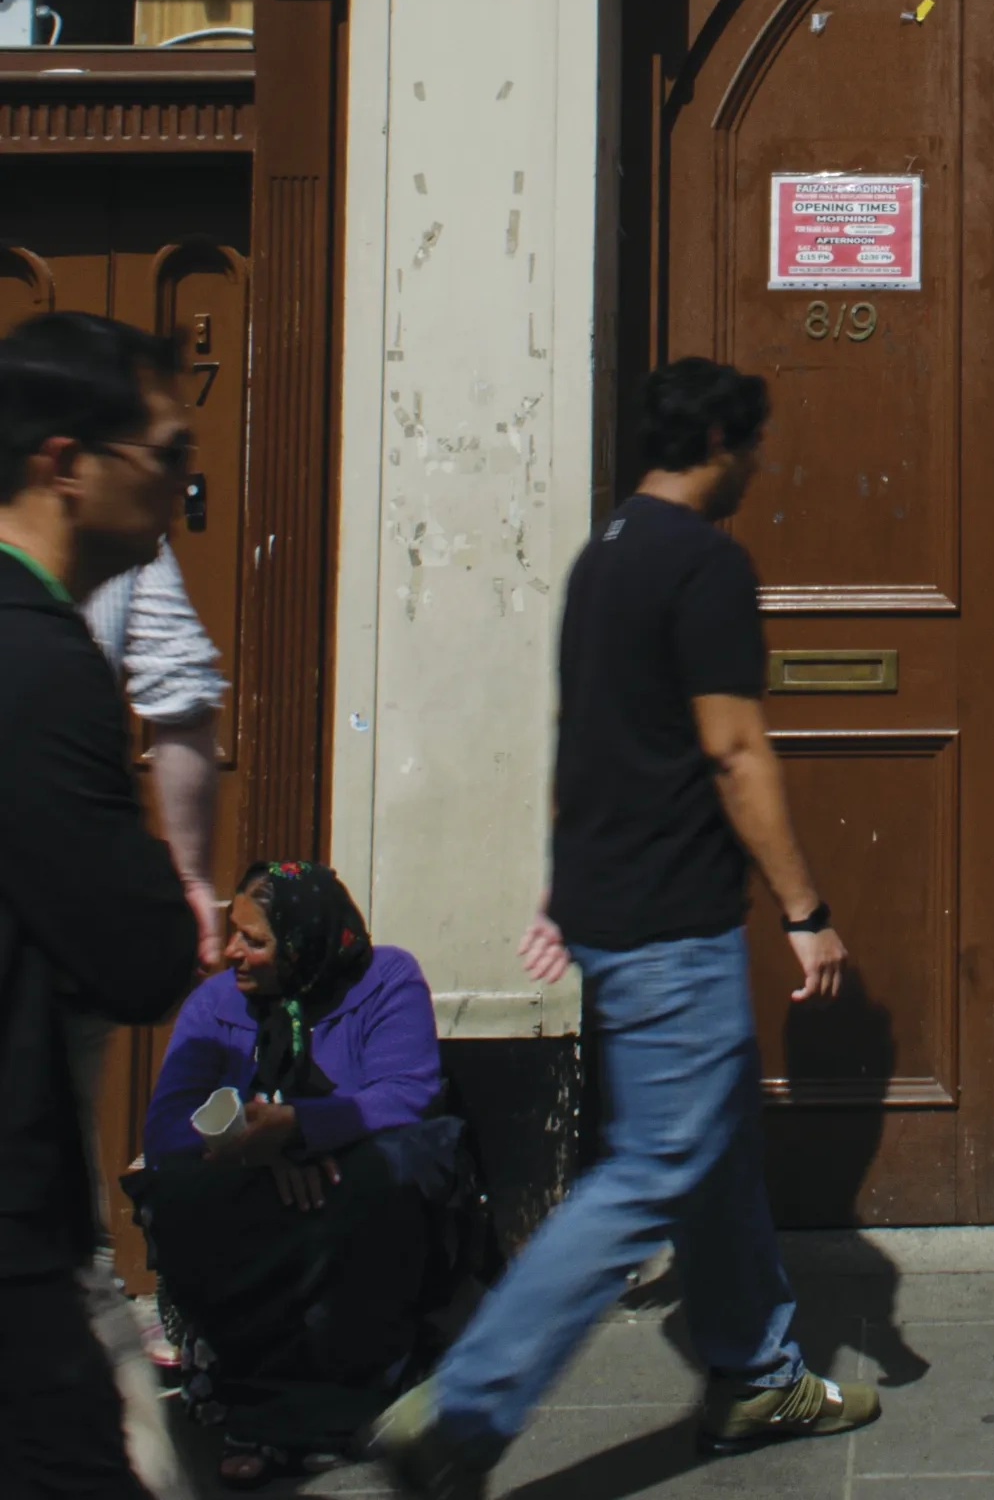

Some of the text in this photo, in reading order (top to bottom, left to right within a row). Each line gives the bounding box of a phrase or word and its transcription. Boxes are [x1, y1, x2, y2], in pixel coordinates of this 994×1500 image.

[796, 184, 897, 194] FAIZAN-EADINAH
[794, 203, 897, 212] OPENING TIMES
[816, 215, 876, 223] MORNING
[804, 300, 878, 342] 8/9
[193, 361, 220, 408] 7
